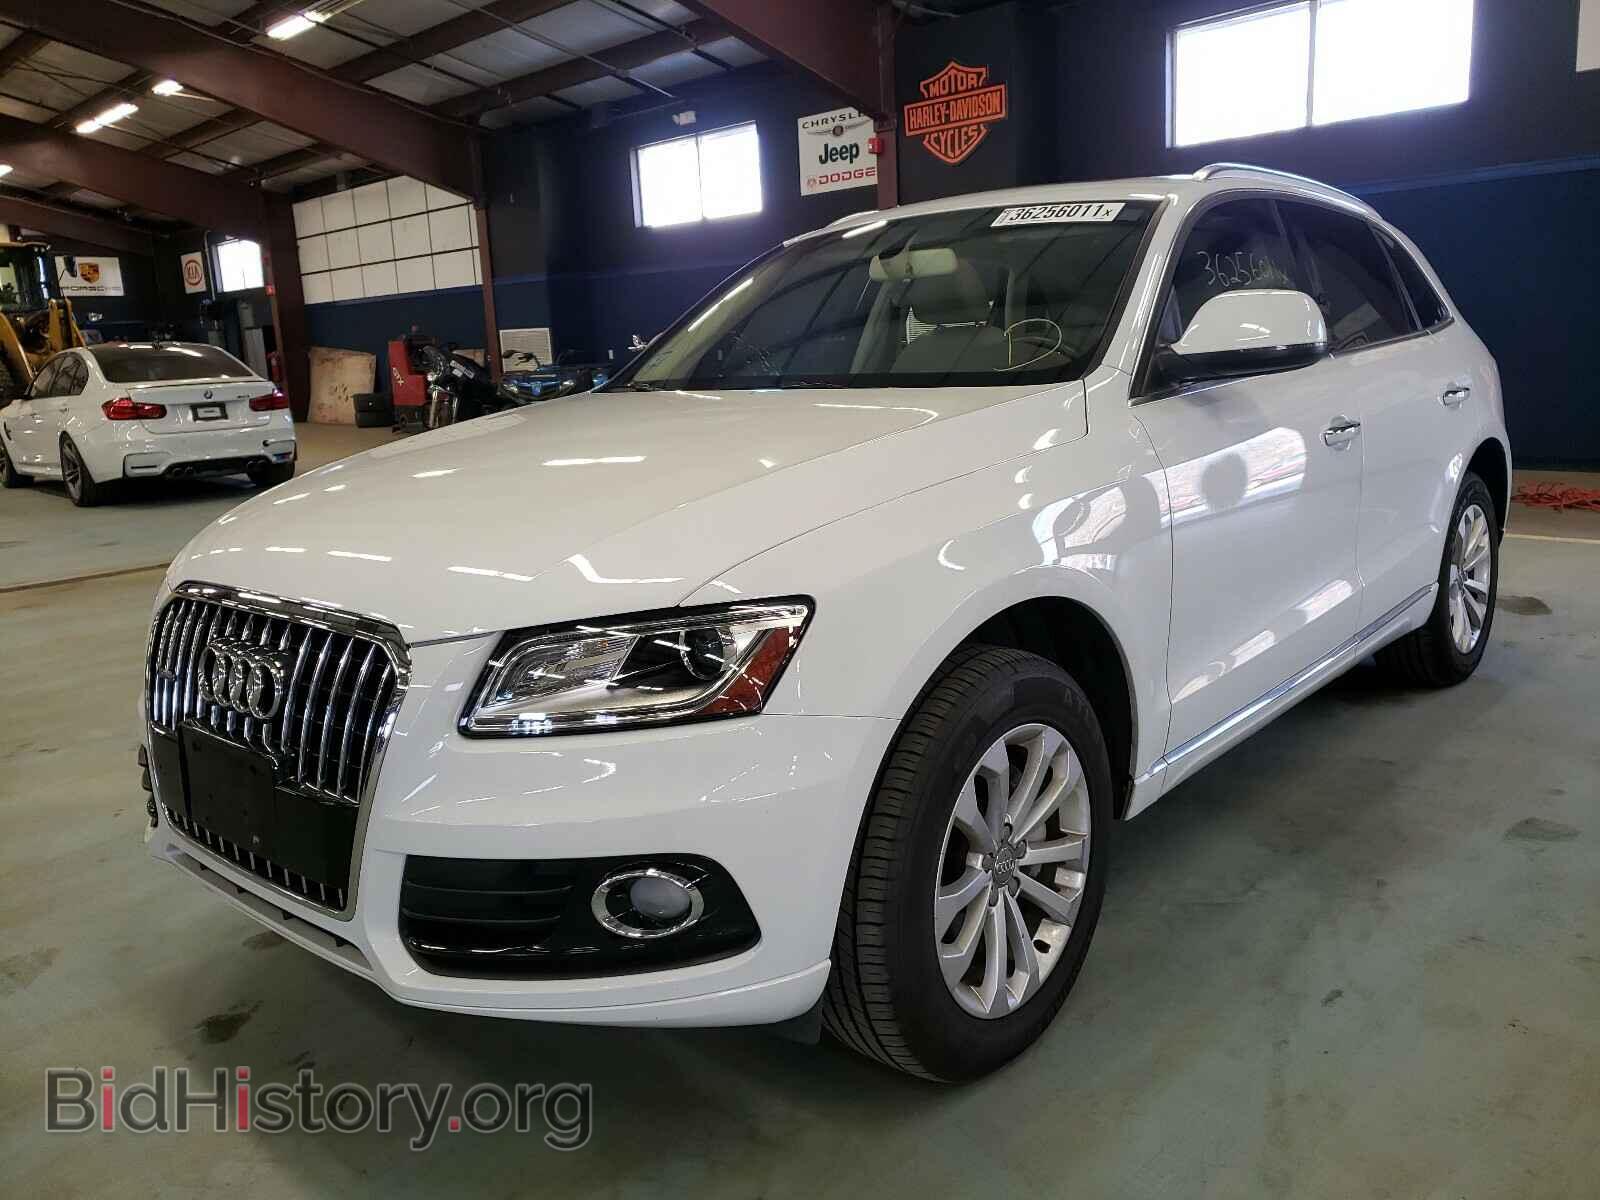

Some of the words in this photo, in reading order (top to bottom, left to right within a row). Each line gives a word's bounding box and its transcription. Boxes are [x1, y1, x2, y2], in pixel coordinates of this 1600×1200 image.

[928, 69, 982, 97] MOTOR
[802, 112, 861, 129] CHRYSL
[908, 91, 1002, 130] HARLEY-DAVIDSON
[818, 142, 860, 165] Jeep
[931, 126, 979, 158] CYCLES
[818, 166, 876, 185] DODGE
[1010, 203, 1105, 220] 36256011
